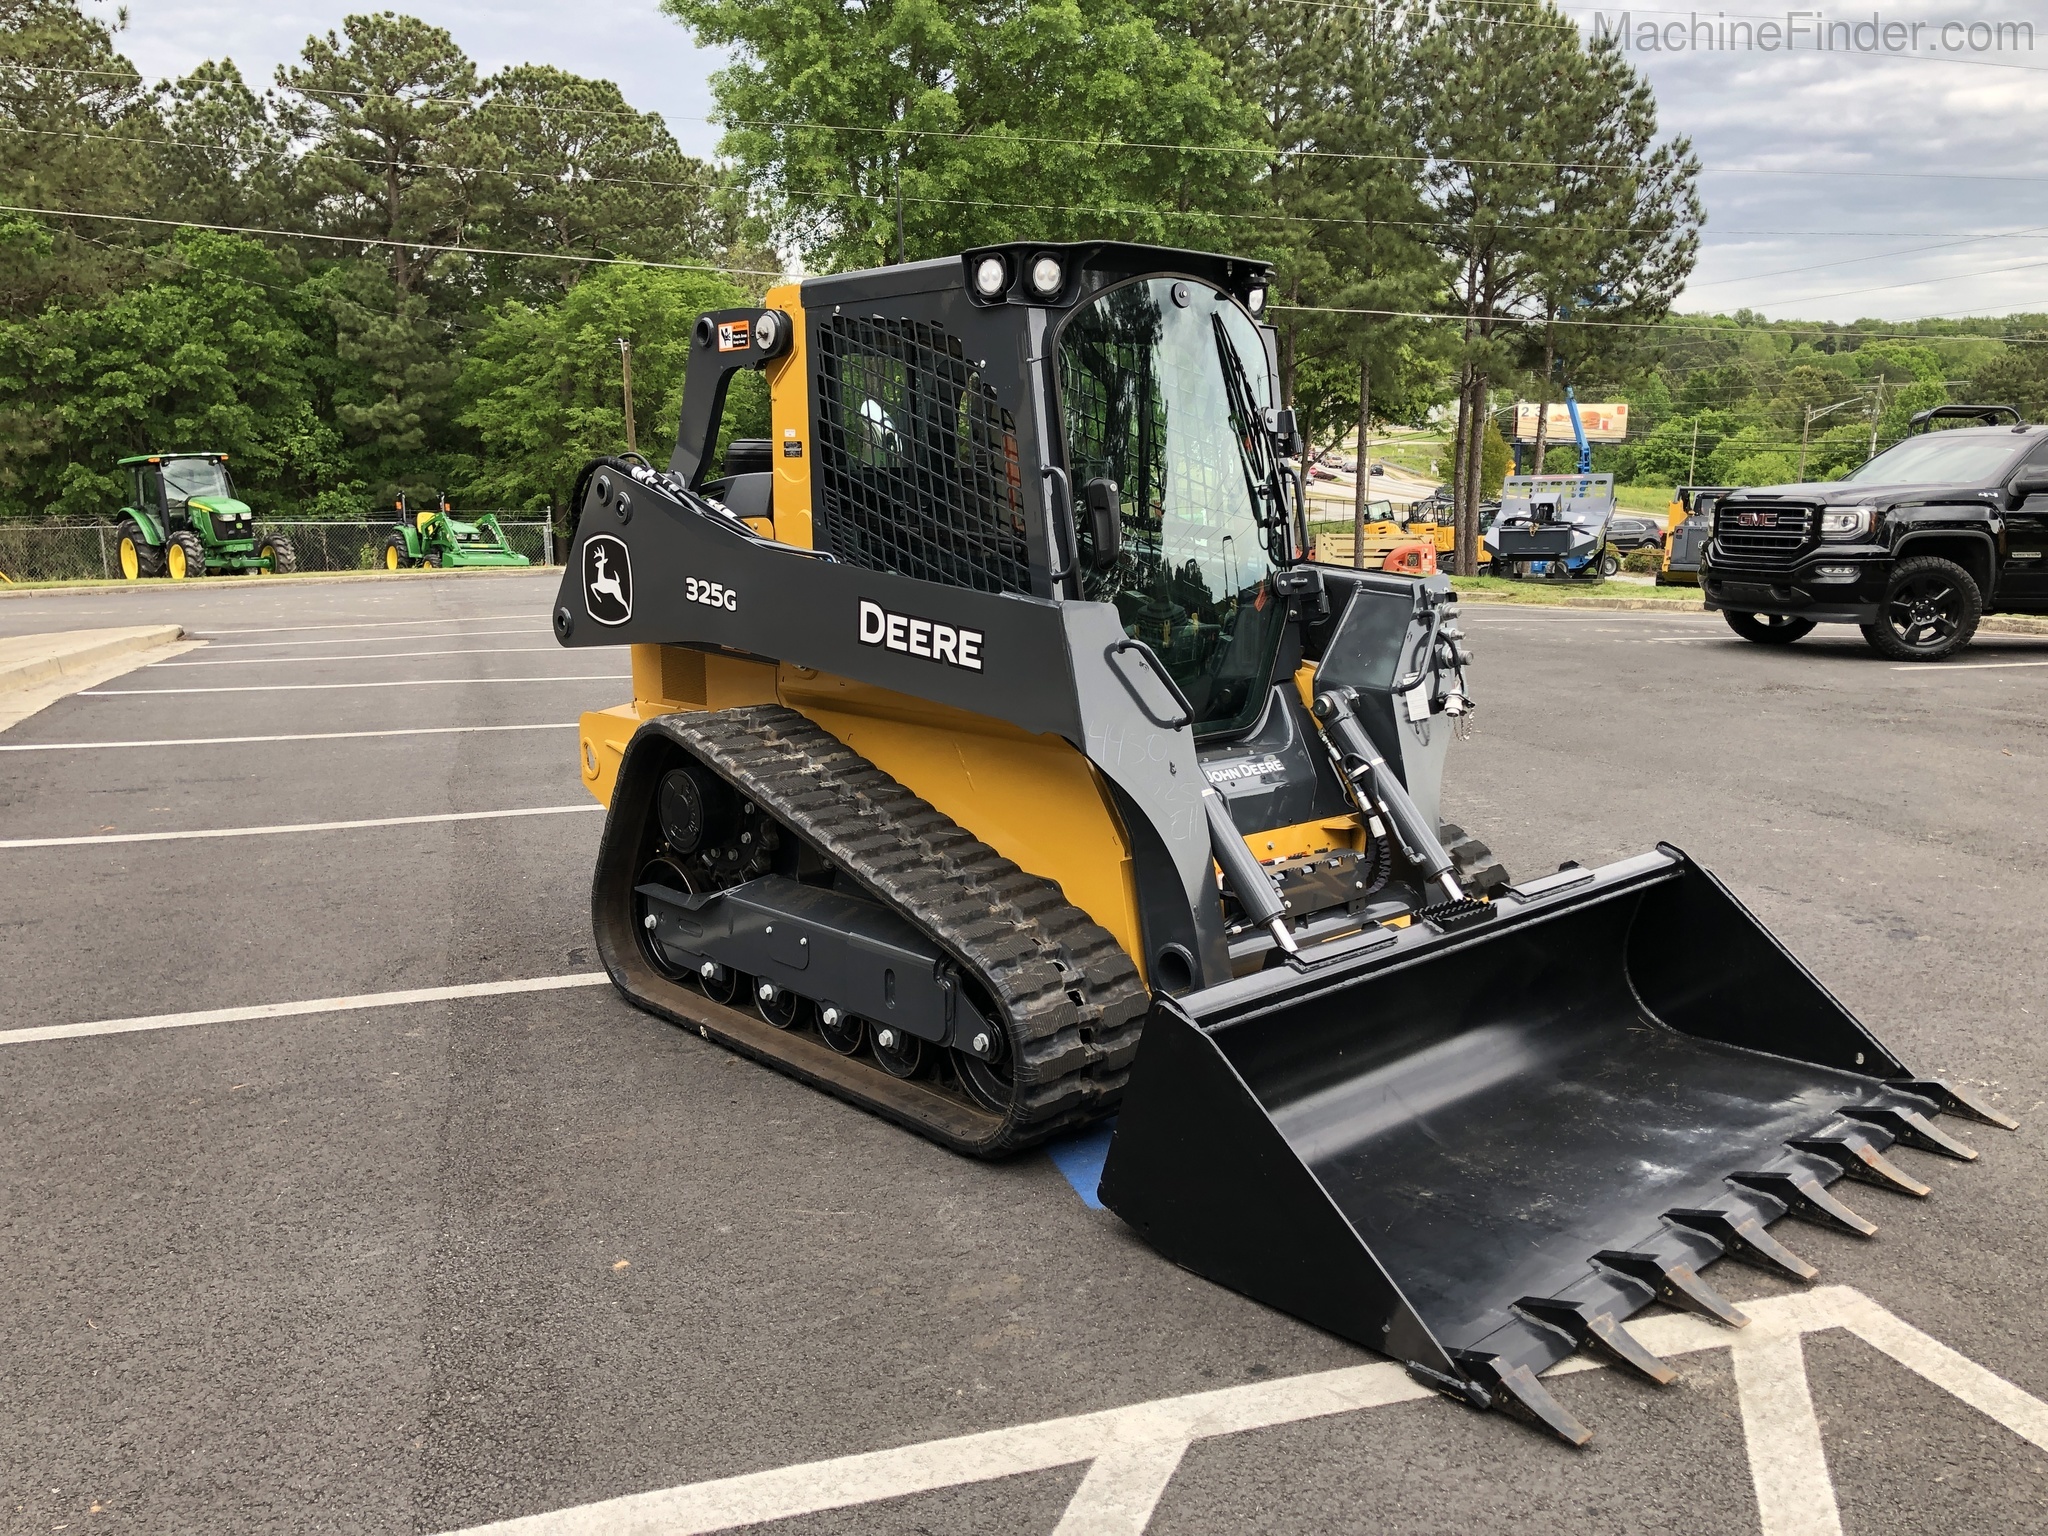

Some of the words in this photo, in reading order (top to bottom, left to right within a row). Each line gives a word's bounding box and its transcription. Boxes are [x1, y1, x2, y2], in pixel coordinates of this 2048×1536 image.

[1738, 512, 1778, 527] GMC
[685, 576, 737, 612] 325G
[859, 599, 984, 671] DEERE
[1205, 763, 1242, 783] JOHN
[1238, 759, 1286, 778] DEERE
